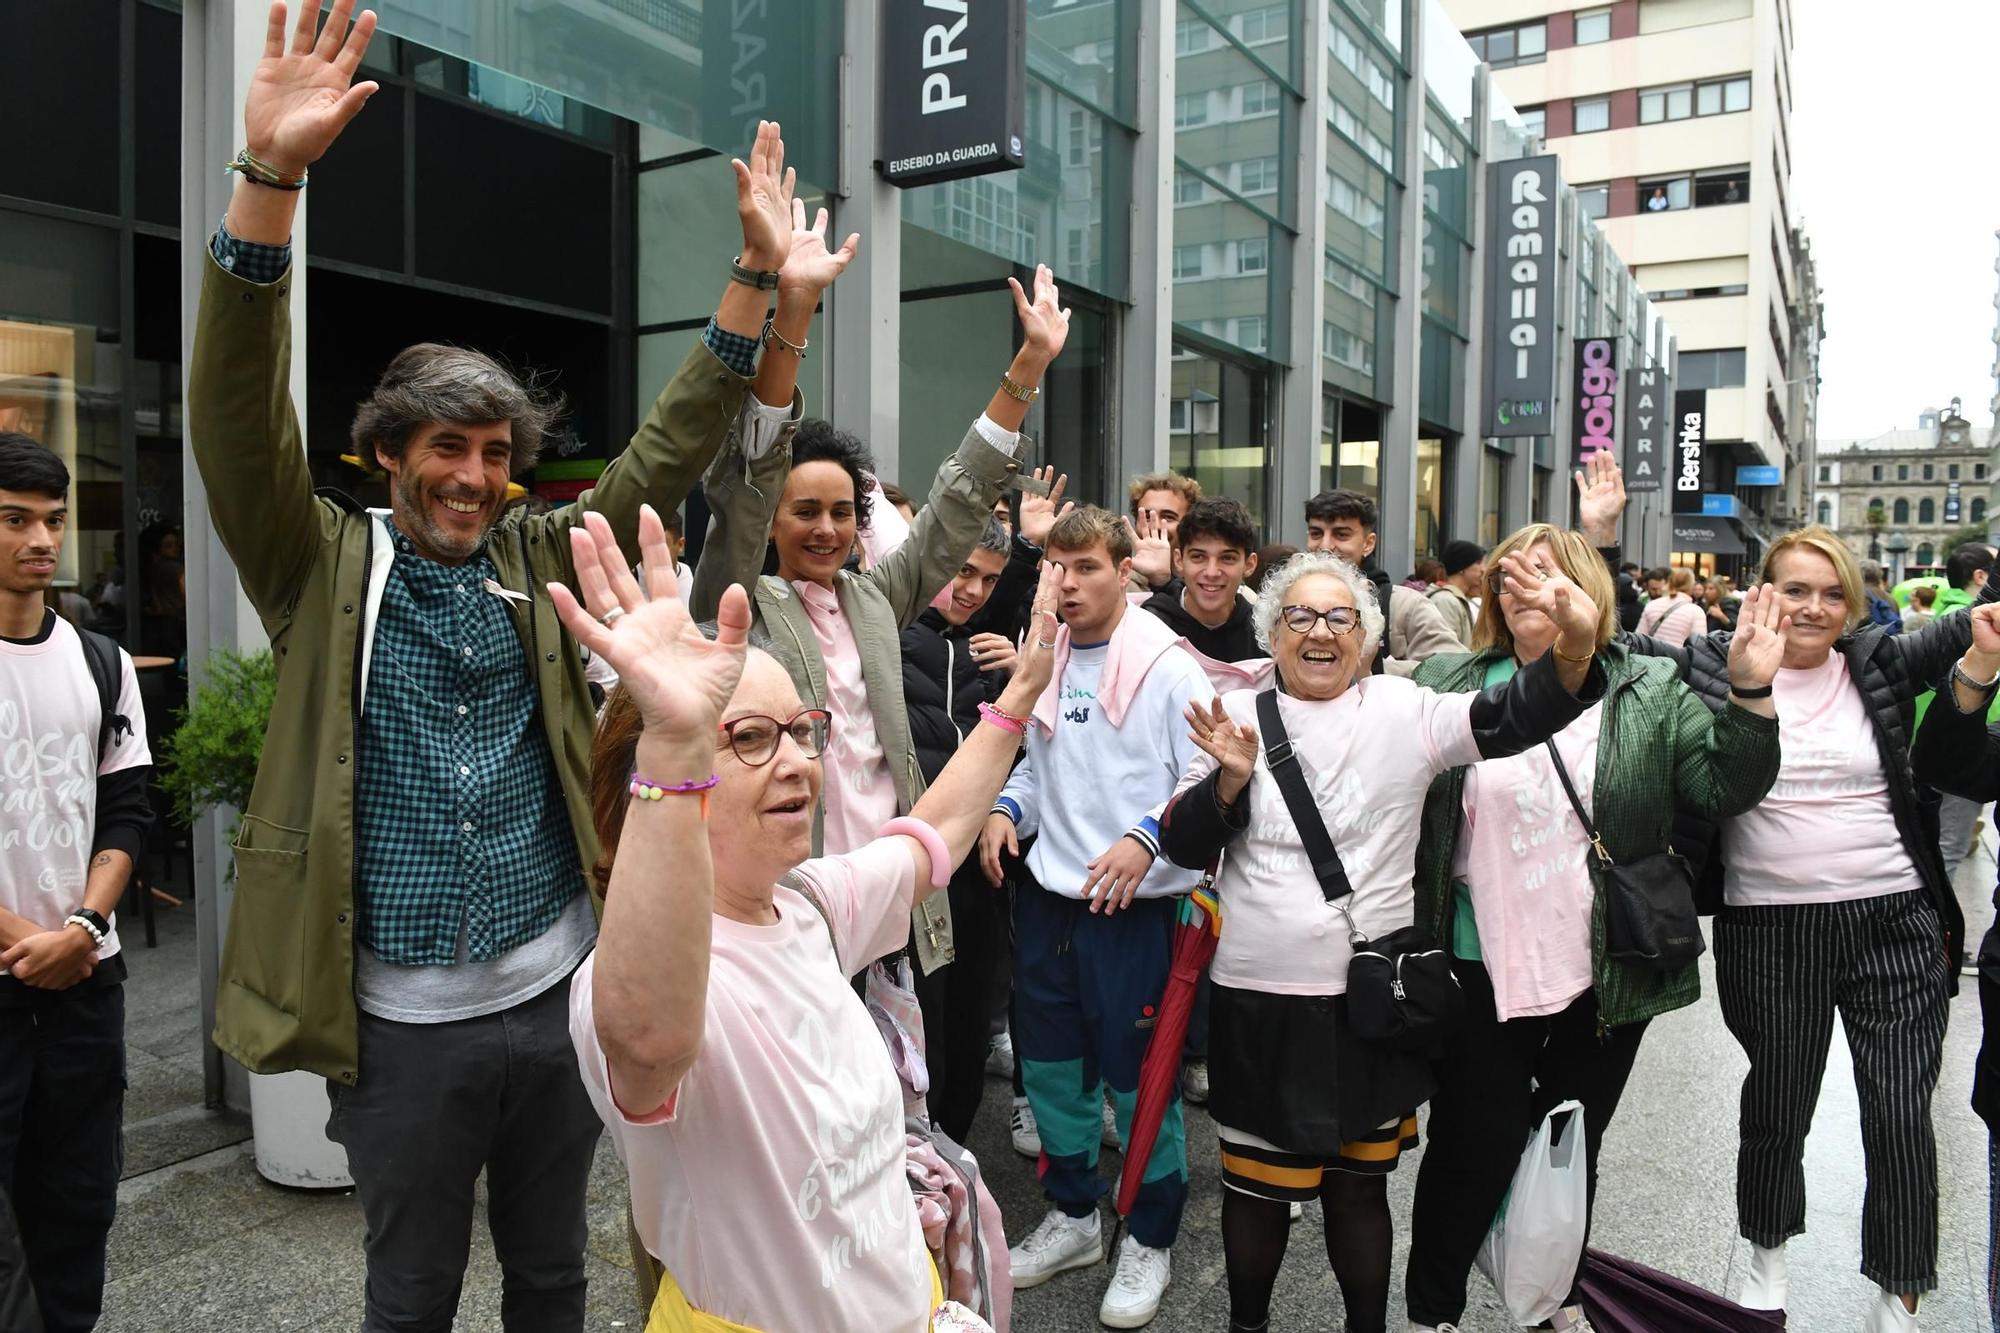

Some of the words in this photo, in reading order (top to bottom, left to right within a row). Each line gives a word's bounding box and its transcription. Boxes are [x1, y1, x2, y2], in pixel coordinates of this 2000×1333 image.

[890, 154, 934, 173] EUSEBIO
[936, 152, 950, 164] DA
[952, 142, 998, 161] GUARDA
[1636, 372, 1655, 475] NAYRA
[1677, 412, 1701, 491] Bershka
[0, 733, 88, 780] OSA
